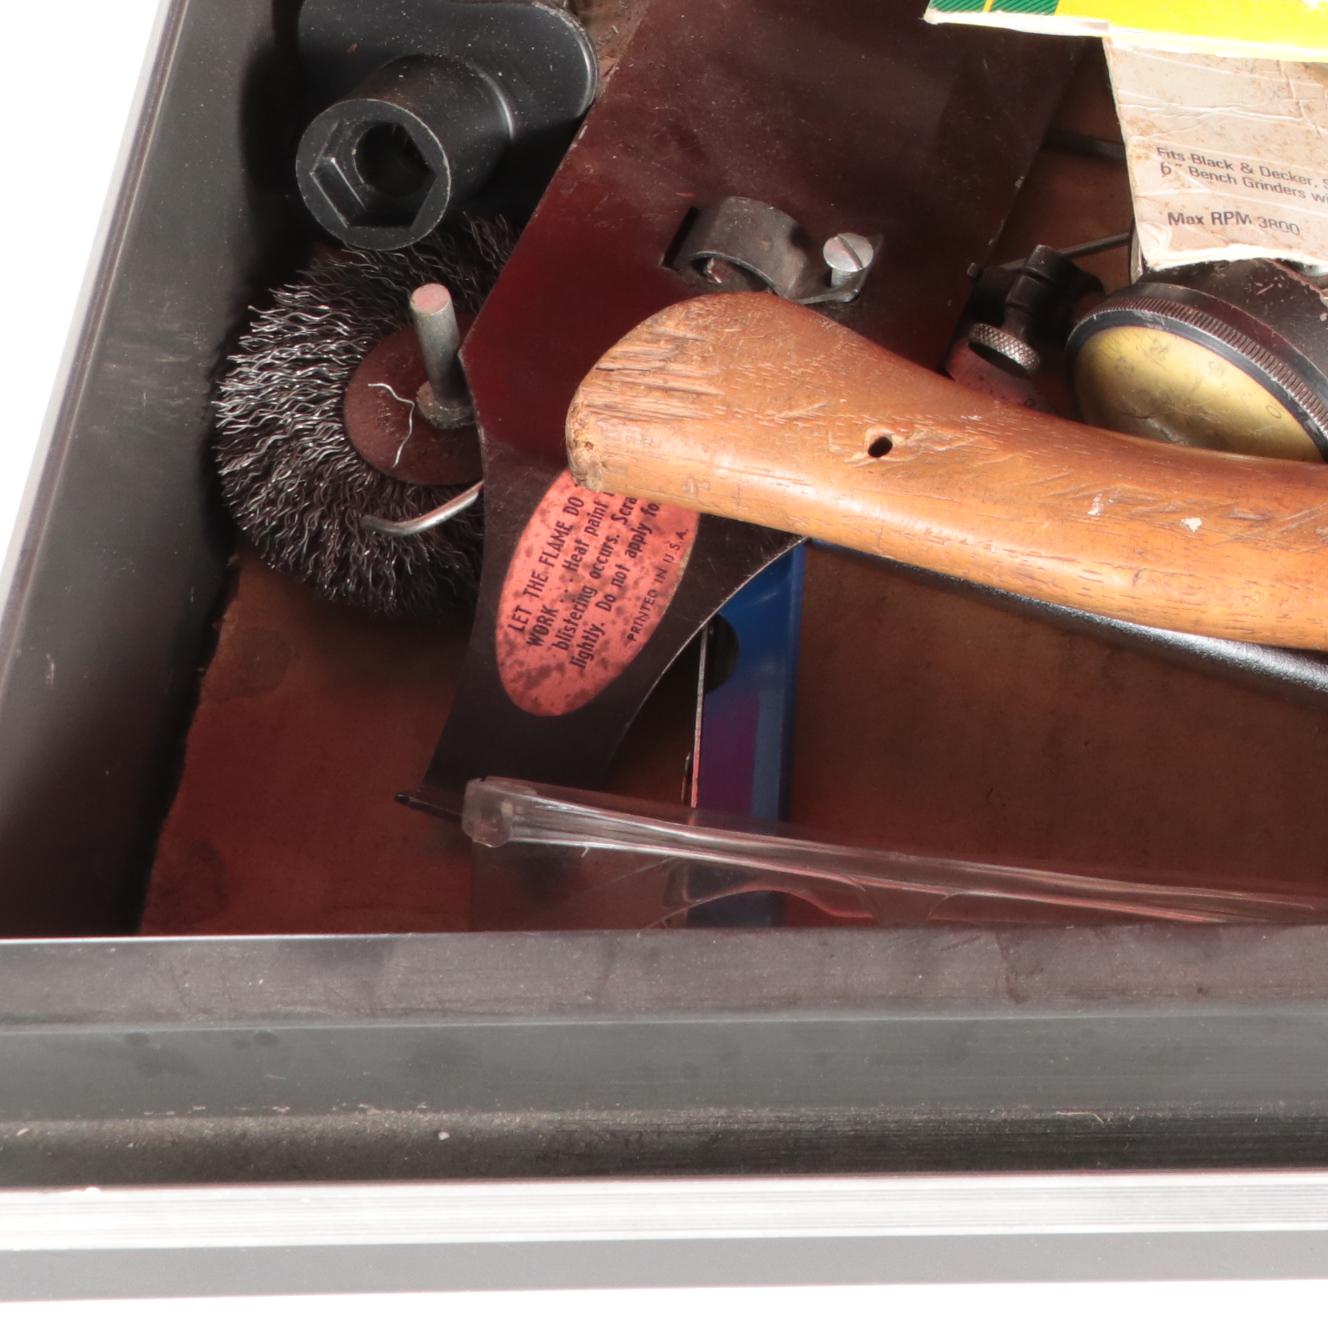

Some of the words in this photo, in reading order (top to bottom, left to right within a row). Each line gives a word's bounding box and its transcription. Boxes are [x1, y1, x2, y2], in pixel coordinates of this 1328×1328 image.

[1157, 146, 1185, 162] Fits
[1191, 153, 1233, 170] Black
[1240, 162, 1254, 174] &
[1188, 166, 1238, 185] Bench
[1242, 176, 1306, 200] Grinders
[1167, 211, 1205, 226] Max
[1211, 210, 1253, 225] RPM
[508, 604, 532, 633] LET
[523, 572, 549, 600] THE
[538, 520, 573, 567] FLAME
[566, 496, 585, 516] DO
[526, 607, 559, 647] WORK
[562, 539, 591, 573] Heat
[585, 499, 609, 537] paint
[551, 586, 598, 651] blistering
[592, 534, 621, 580] occurs.
[570, 621, 605, 670] lightly.
[595, 593, 617, 612] Do
[613, 564, 631, 589] not
[624, 521, 654, 559] apply
[627, 590, 659, 642] PRINTED
[655, 567, 668, 585] IN
